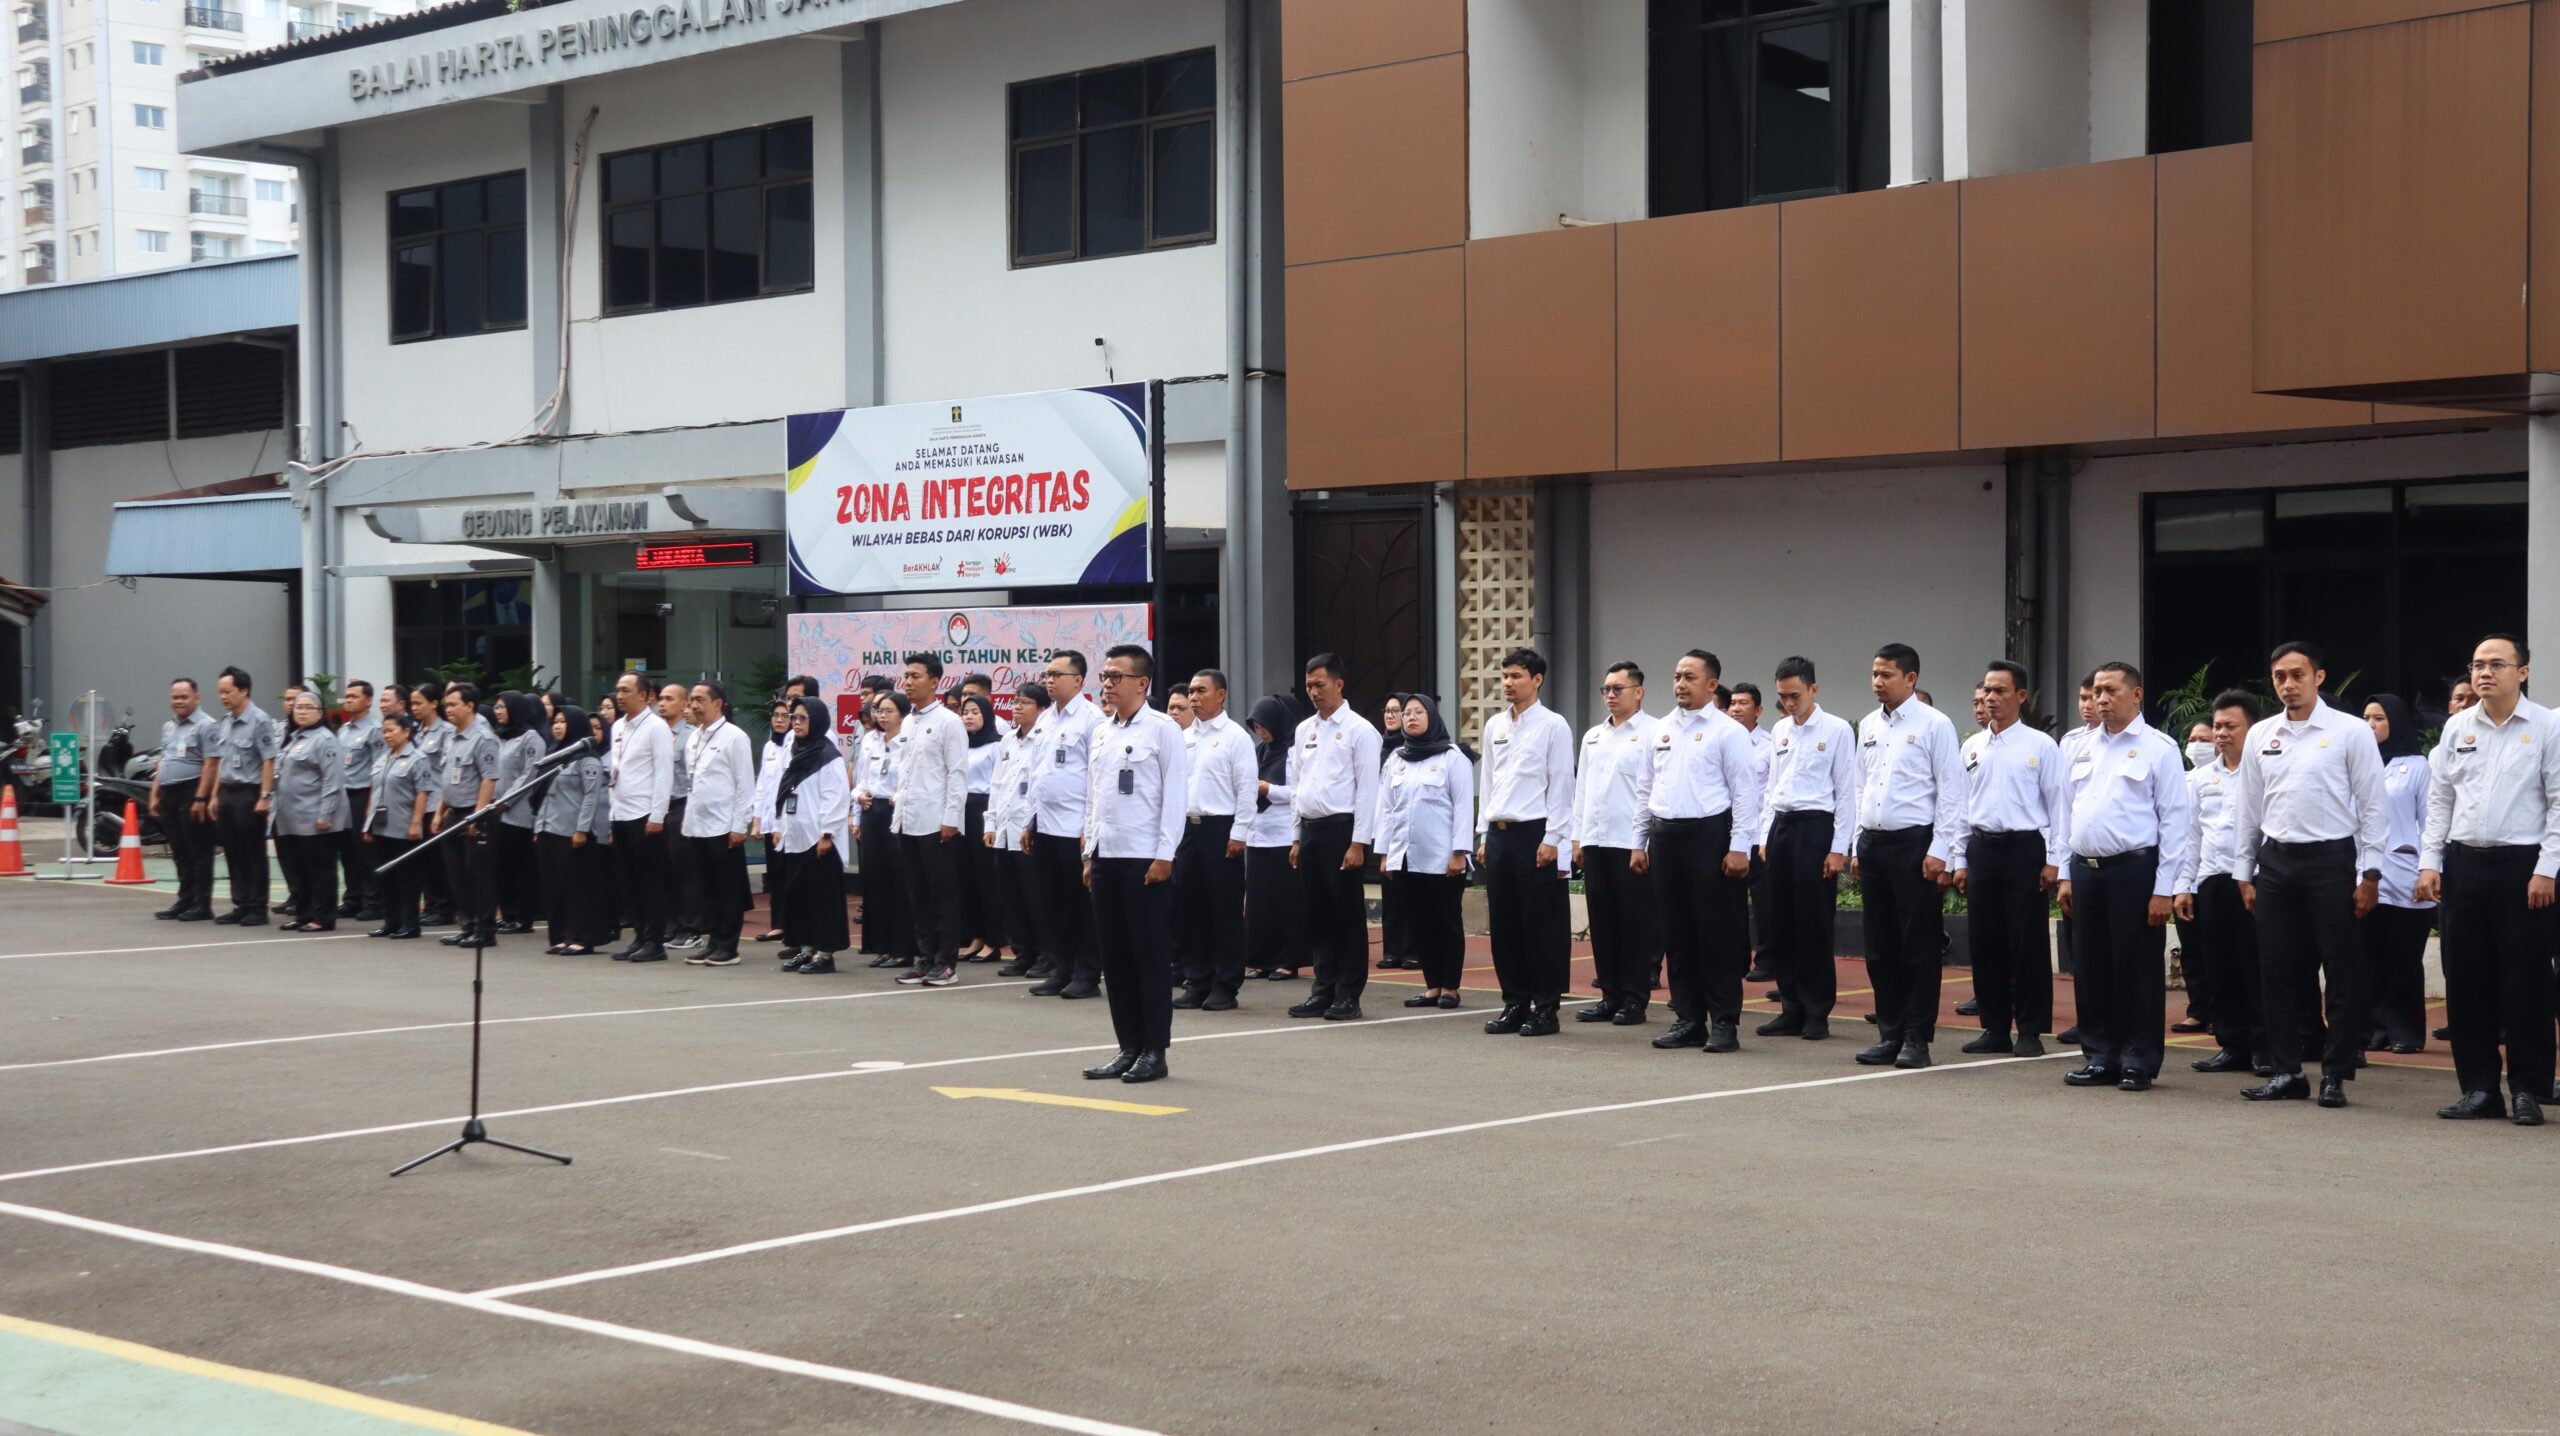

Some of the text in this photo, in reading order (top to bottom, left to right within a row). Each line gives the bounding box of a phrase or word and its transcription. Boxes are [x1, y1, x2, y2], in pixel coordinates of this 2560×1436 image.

[349, 0, 766, 100] BALAI HARTA PENINGGALAN
[916, 443, 1000, 458] SELAMAT DATANG
[895, 452, 1024, 471] ANDA MEMASUKI KAWASAN
[836, 469, 1090, 525] ZONA INTEGRITAS
[462, 501, 649, 538] GEDUNG PELAYANAN
[852, 523, 1073, 547] WILAYAH BEBAS DARI KORUPSI (WBK)
[903, 562, 941, 573] BerAKHLAK
[863, 651, 897, 665] HARI
[958, 649, 1011, 664] TAHUN
[1017, 648, 1060, 664] KE-2
